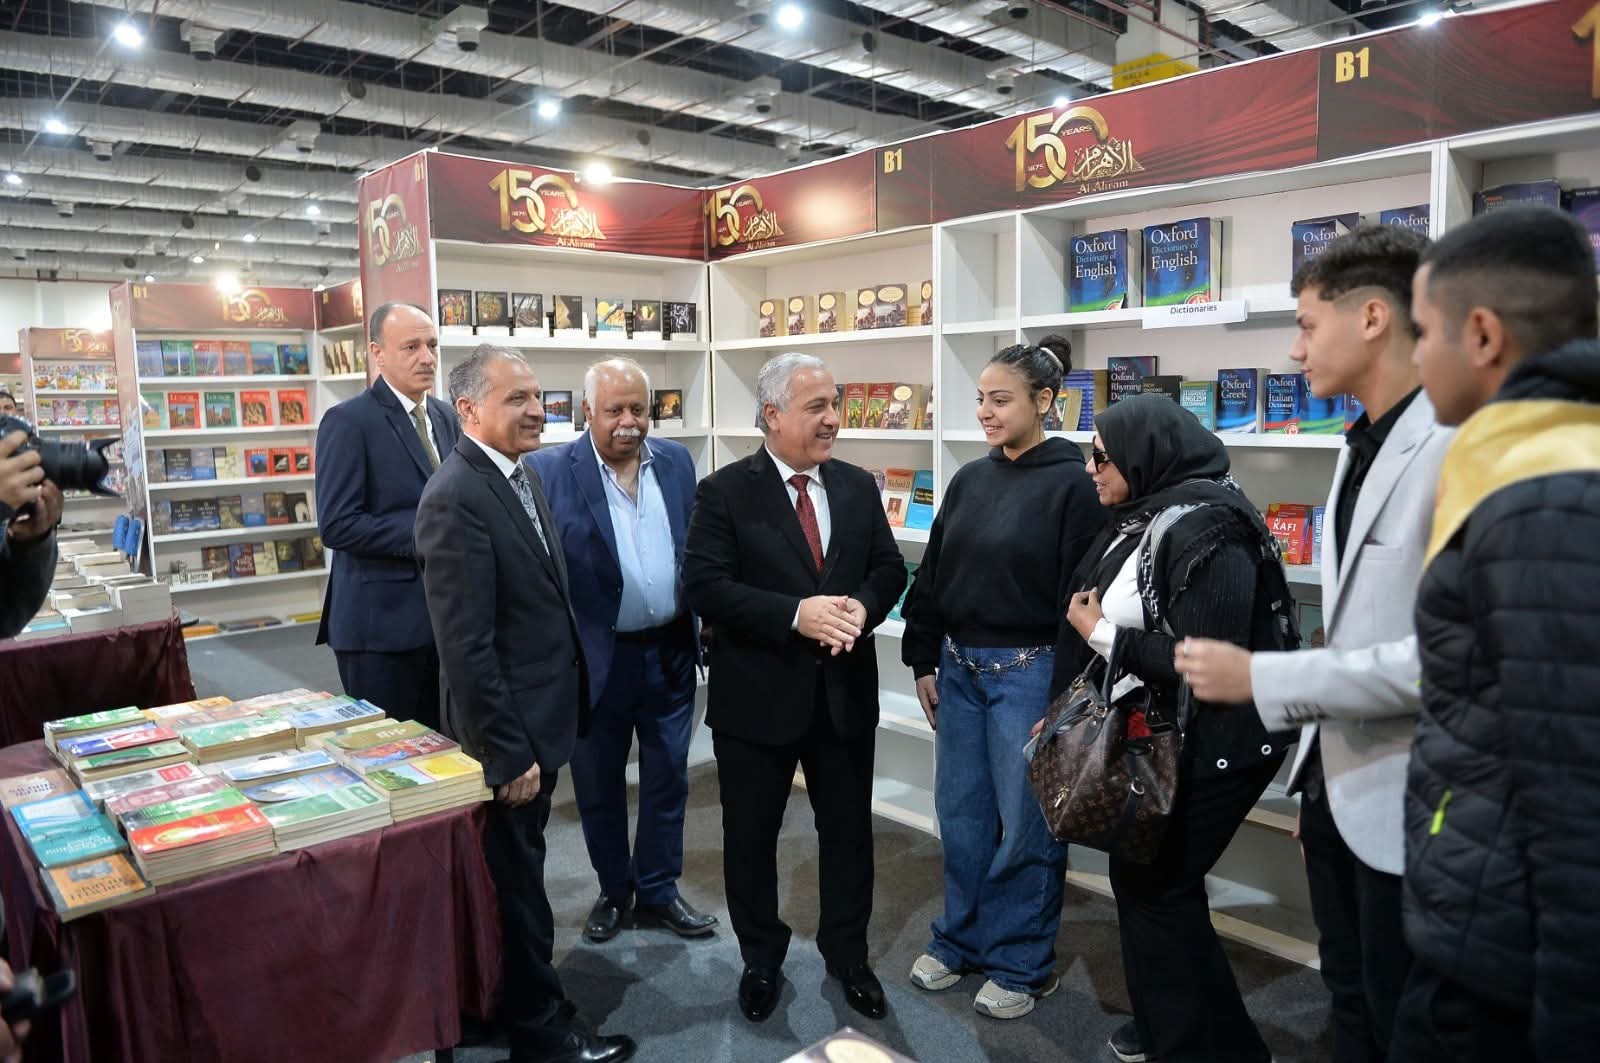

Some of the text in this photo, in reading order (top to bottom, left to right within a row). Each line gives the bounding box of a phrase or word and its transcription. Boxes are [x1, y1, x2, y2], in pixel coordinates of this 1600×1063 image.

[1335, 47, 1370, 83] B1
[1061, 125, 1094, 137] YEARS
[1005, 106, 1109, 192] 150
[884, 148, 903, 173] B1
[488, 168, 579, 234] 150
[706, 185, 763, 248] 150
[1151, 223, 1198, 245] Oxford
[1303, 228, 1339, 243] Oxfor
[1075, 235, 1117, 254] Oxford
[1151, 240, 1199, 256] Dictionary of
[1076, 251, 1117, 264] Dictionary of
[1151, 250, 1198, 272] English
[1075, 261, 1117, 281] English
[1170, 303, 1217, 314] Dictionaries
[1111, 363, 1127, 371] New
[1110, 372, 1135, 381] Oxford
[1268, 377, 1297, 387] Oxford
[1111, 383, 1141, 392] Rhyming
[1221, 379, 1251, 390] Oxford
[1221, 390, 1248, 400] Greek
[1268, 394, 1294, 402] Italian
[1273, 522, 1297, 532] KAFI
